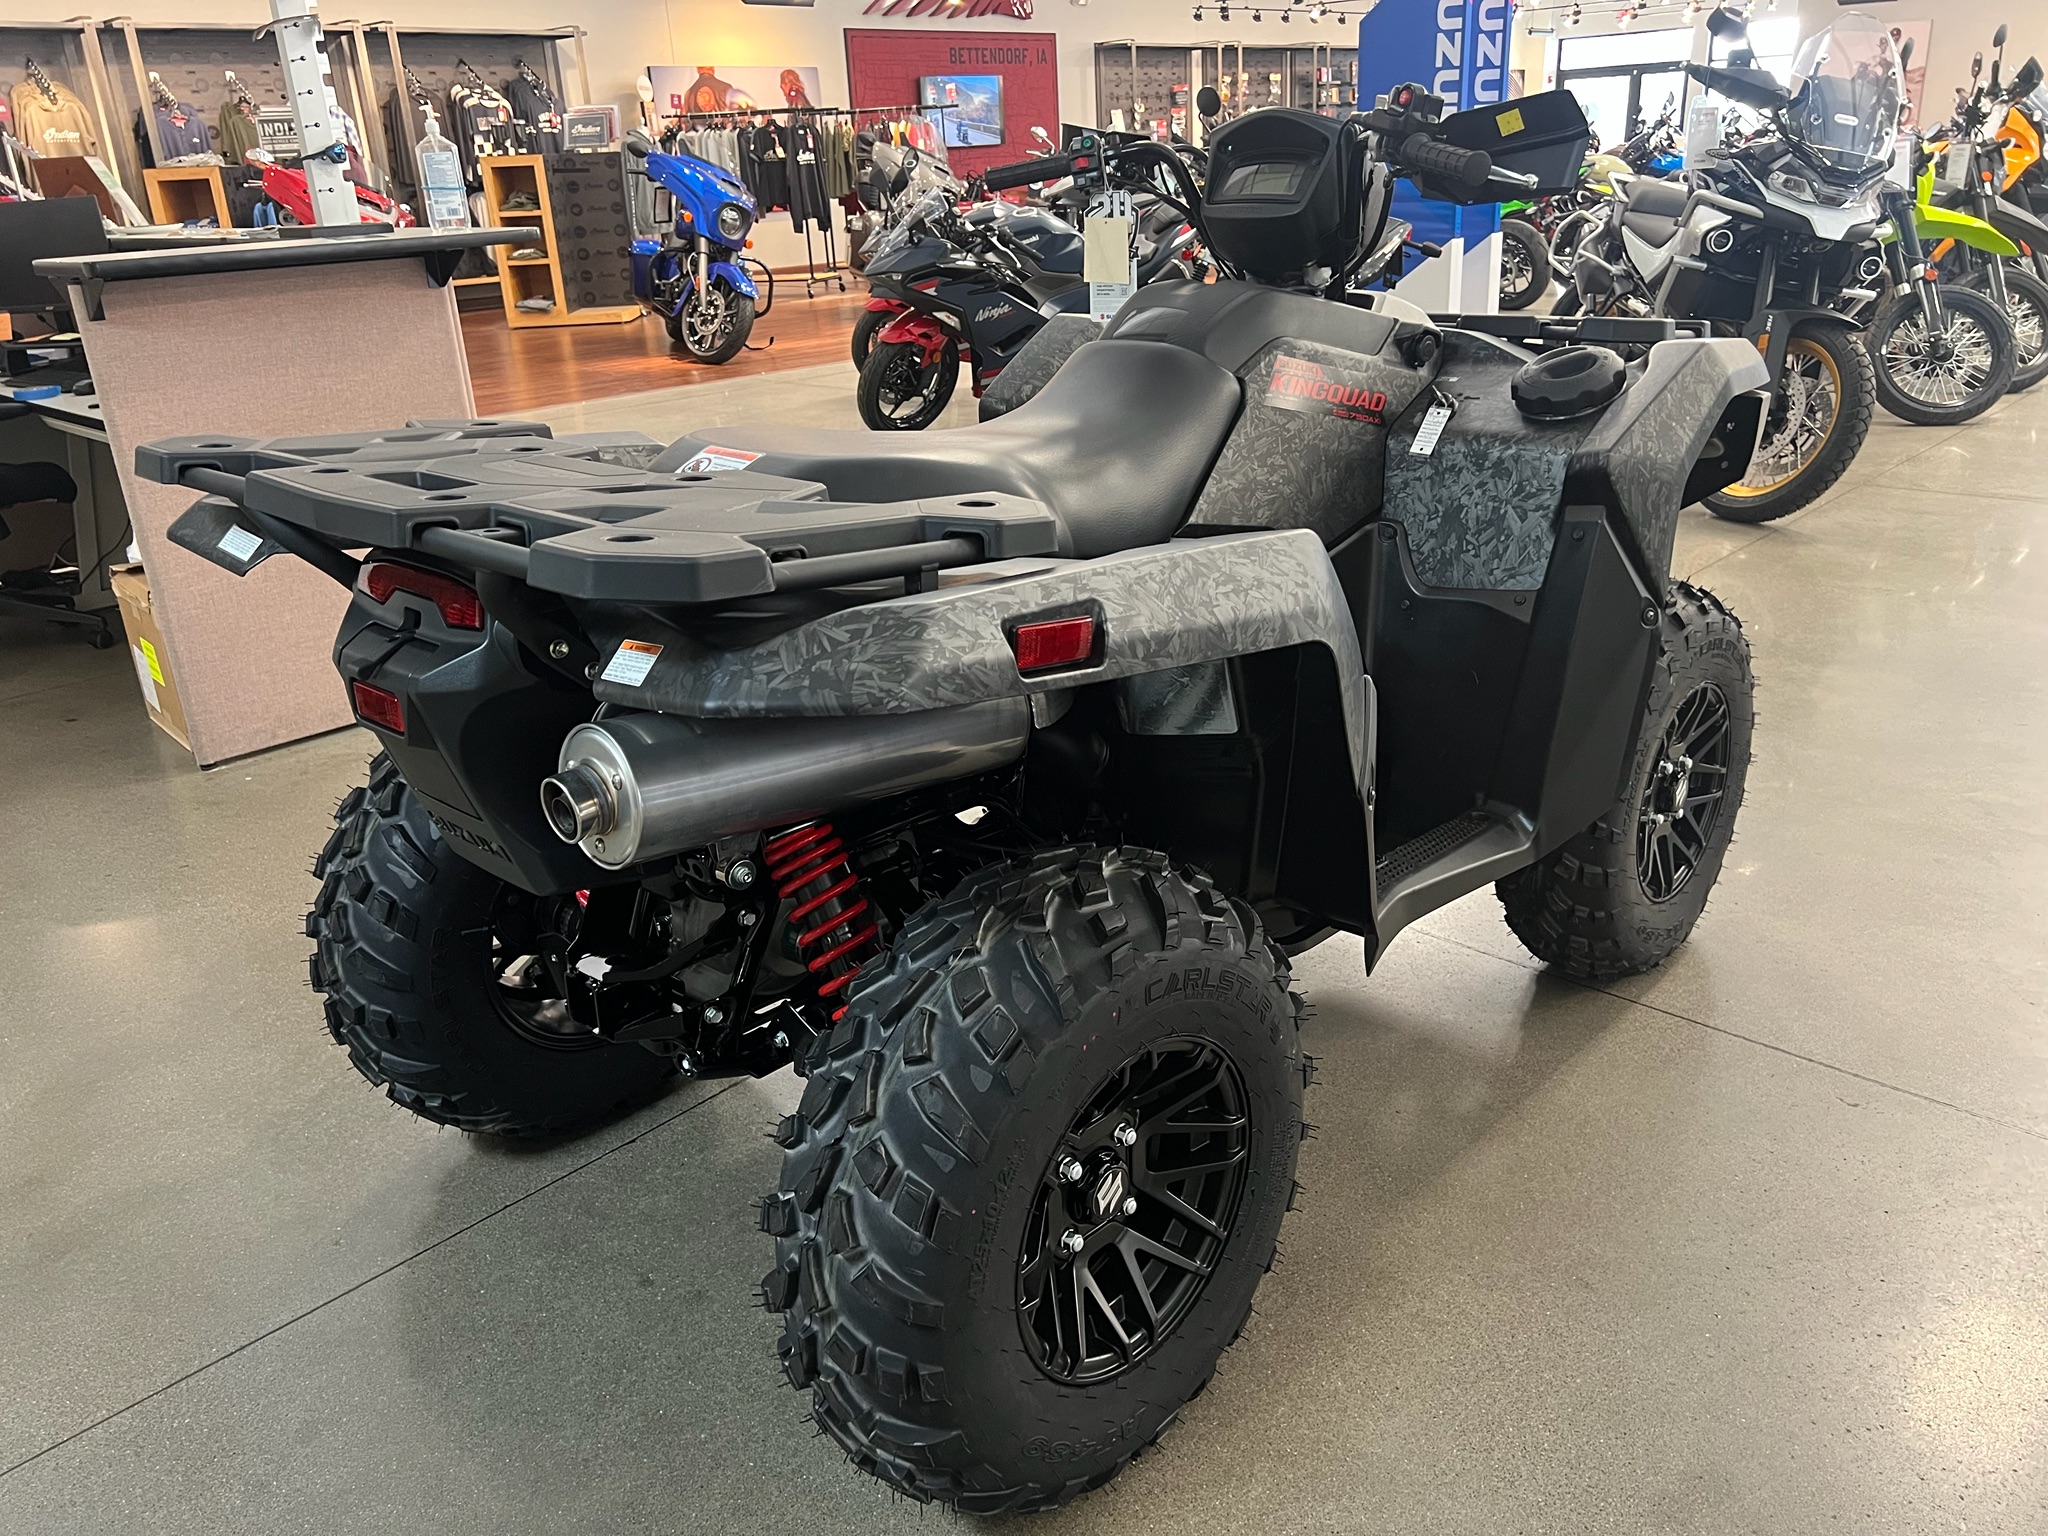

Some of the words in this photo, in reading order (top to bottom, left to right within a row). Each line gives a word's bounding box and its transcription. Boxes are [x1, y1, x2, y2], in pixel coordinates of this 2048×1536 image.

[949, 47, 1032, 67] BETTENDORF,
[1036, 47, 1048, 64] IA
[1433, 0, 1463, 120] UZU
[1474, 0, 1505, 108] UZU
[259, 122, 297, 136] INDI
[975, 301, 1013, 322] Ninja
[1279, 358, 1321, 377] SUZUKI
[1269, 372, 1387, 412] KINGQUAD
[1144, 966, 1273, 1025] CARLSTAR
